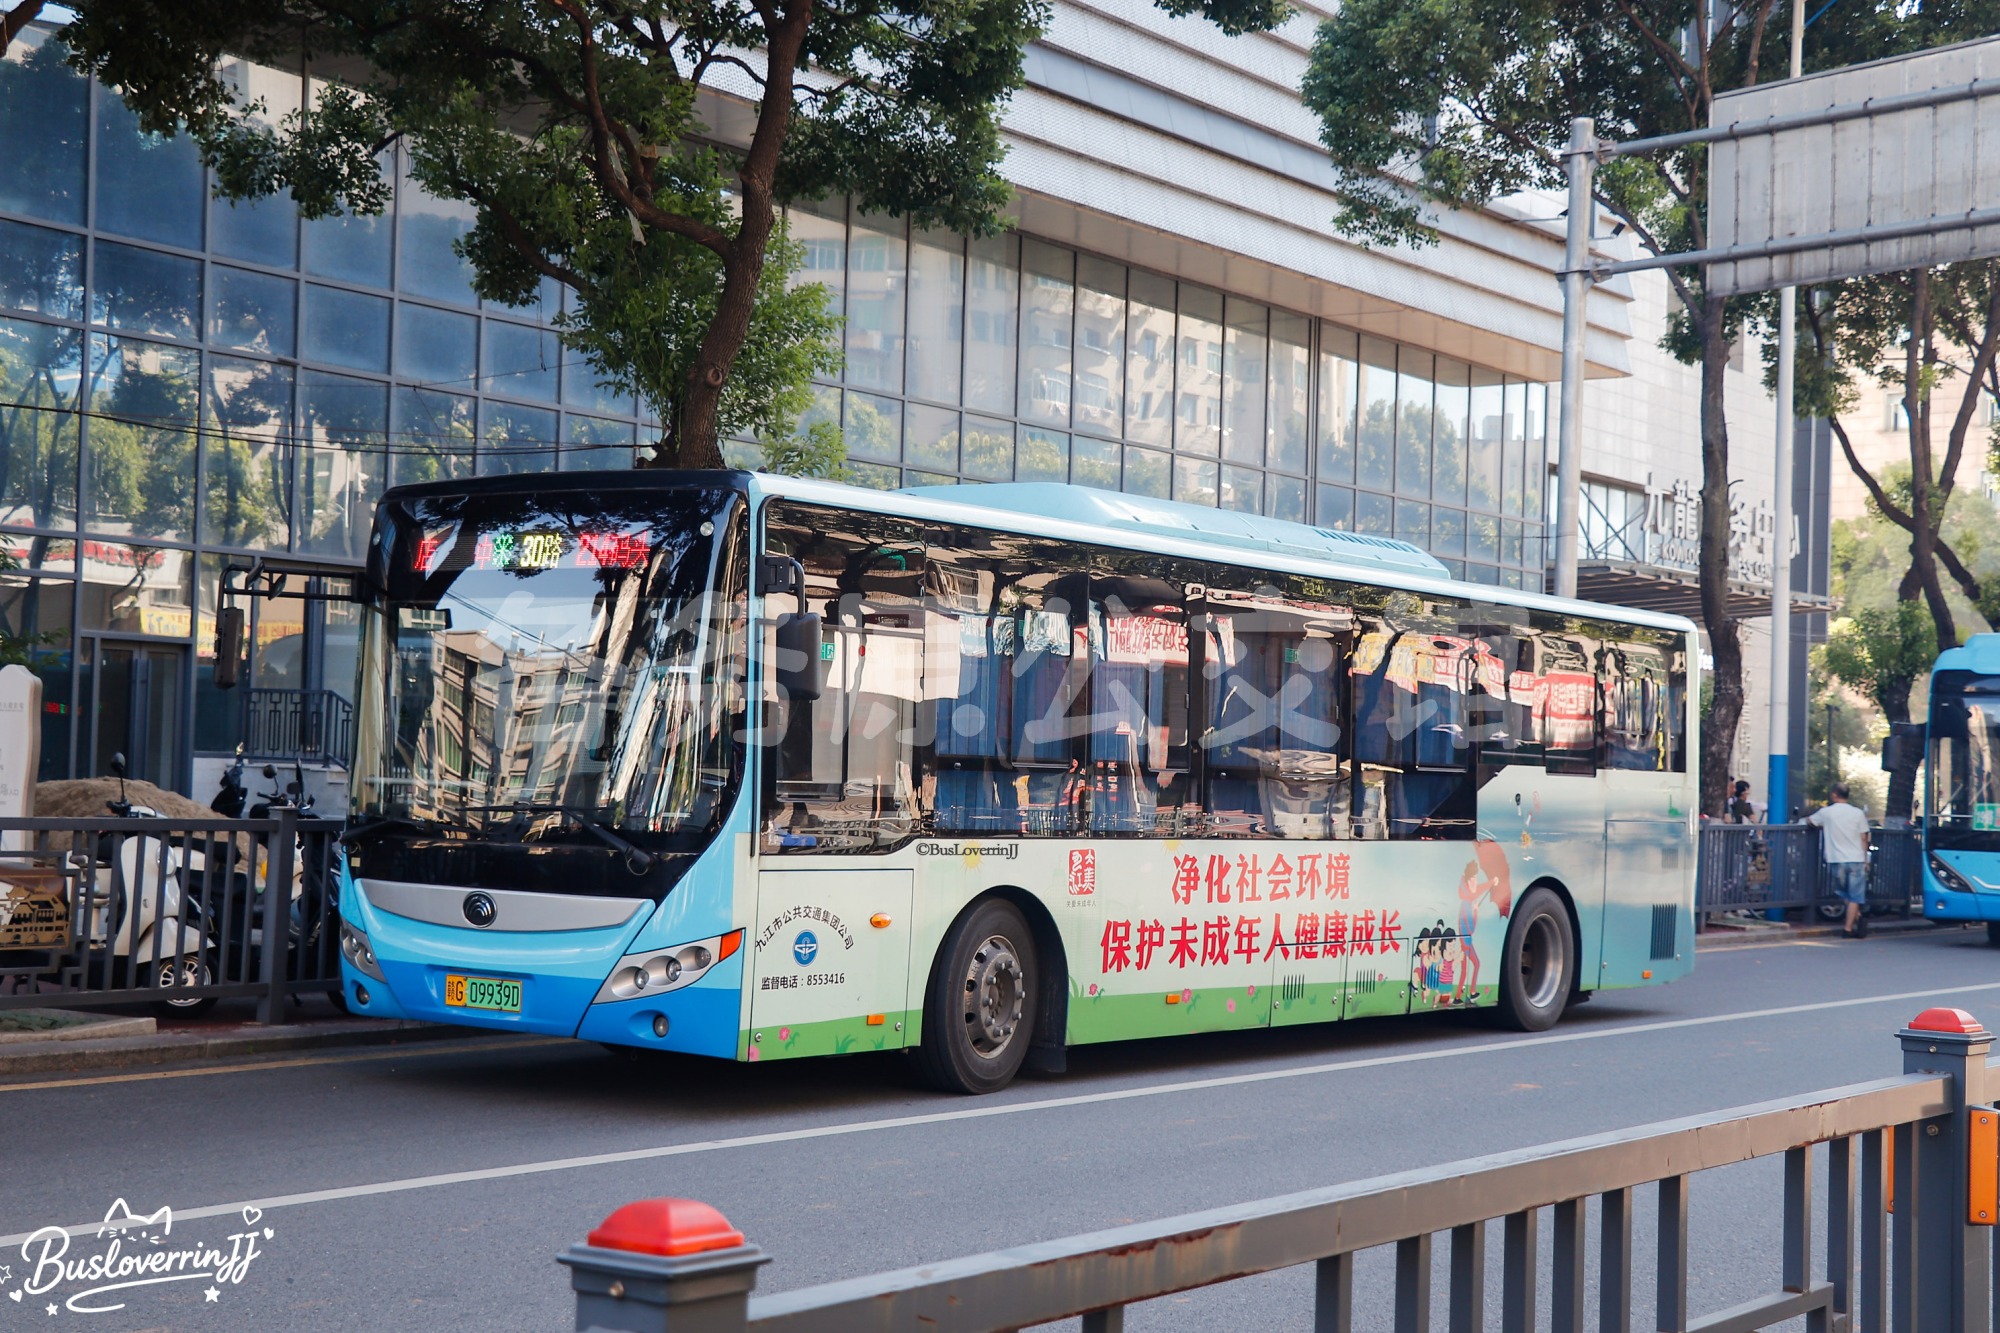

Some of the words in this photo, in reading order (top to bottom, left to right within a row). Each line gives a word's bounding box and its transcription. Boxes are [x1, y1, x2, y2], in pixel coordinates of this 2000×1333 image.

[521, 533, 563, 568] 30路
[1171, 852, 1350, 905] 净化社会环境
[755, 905, 854, 952] 九江市公共交通集团公司
[1100, 909, 1402, 974] 保护未成年人健康成长
